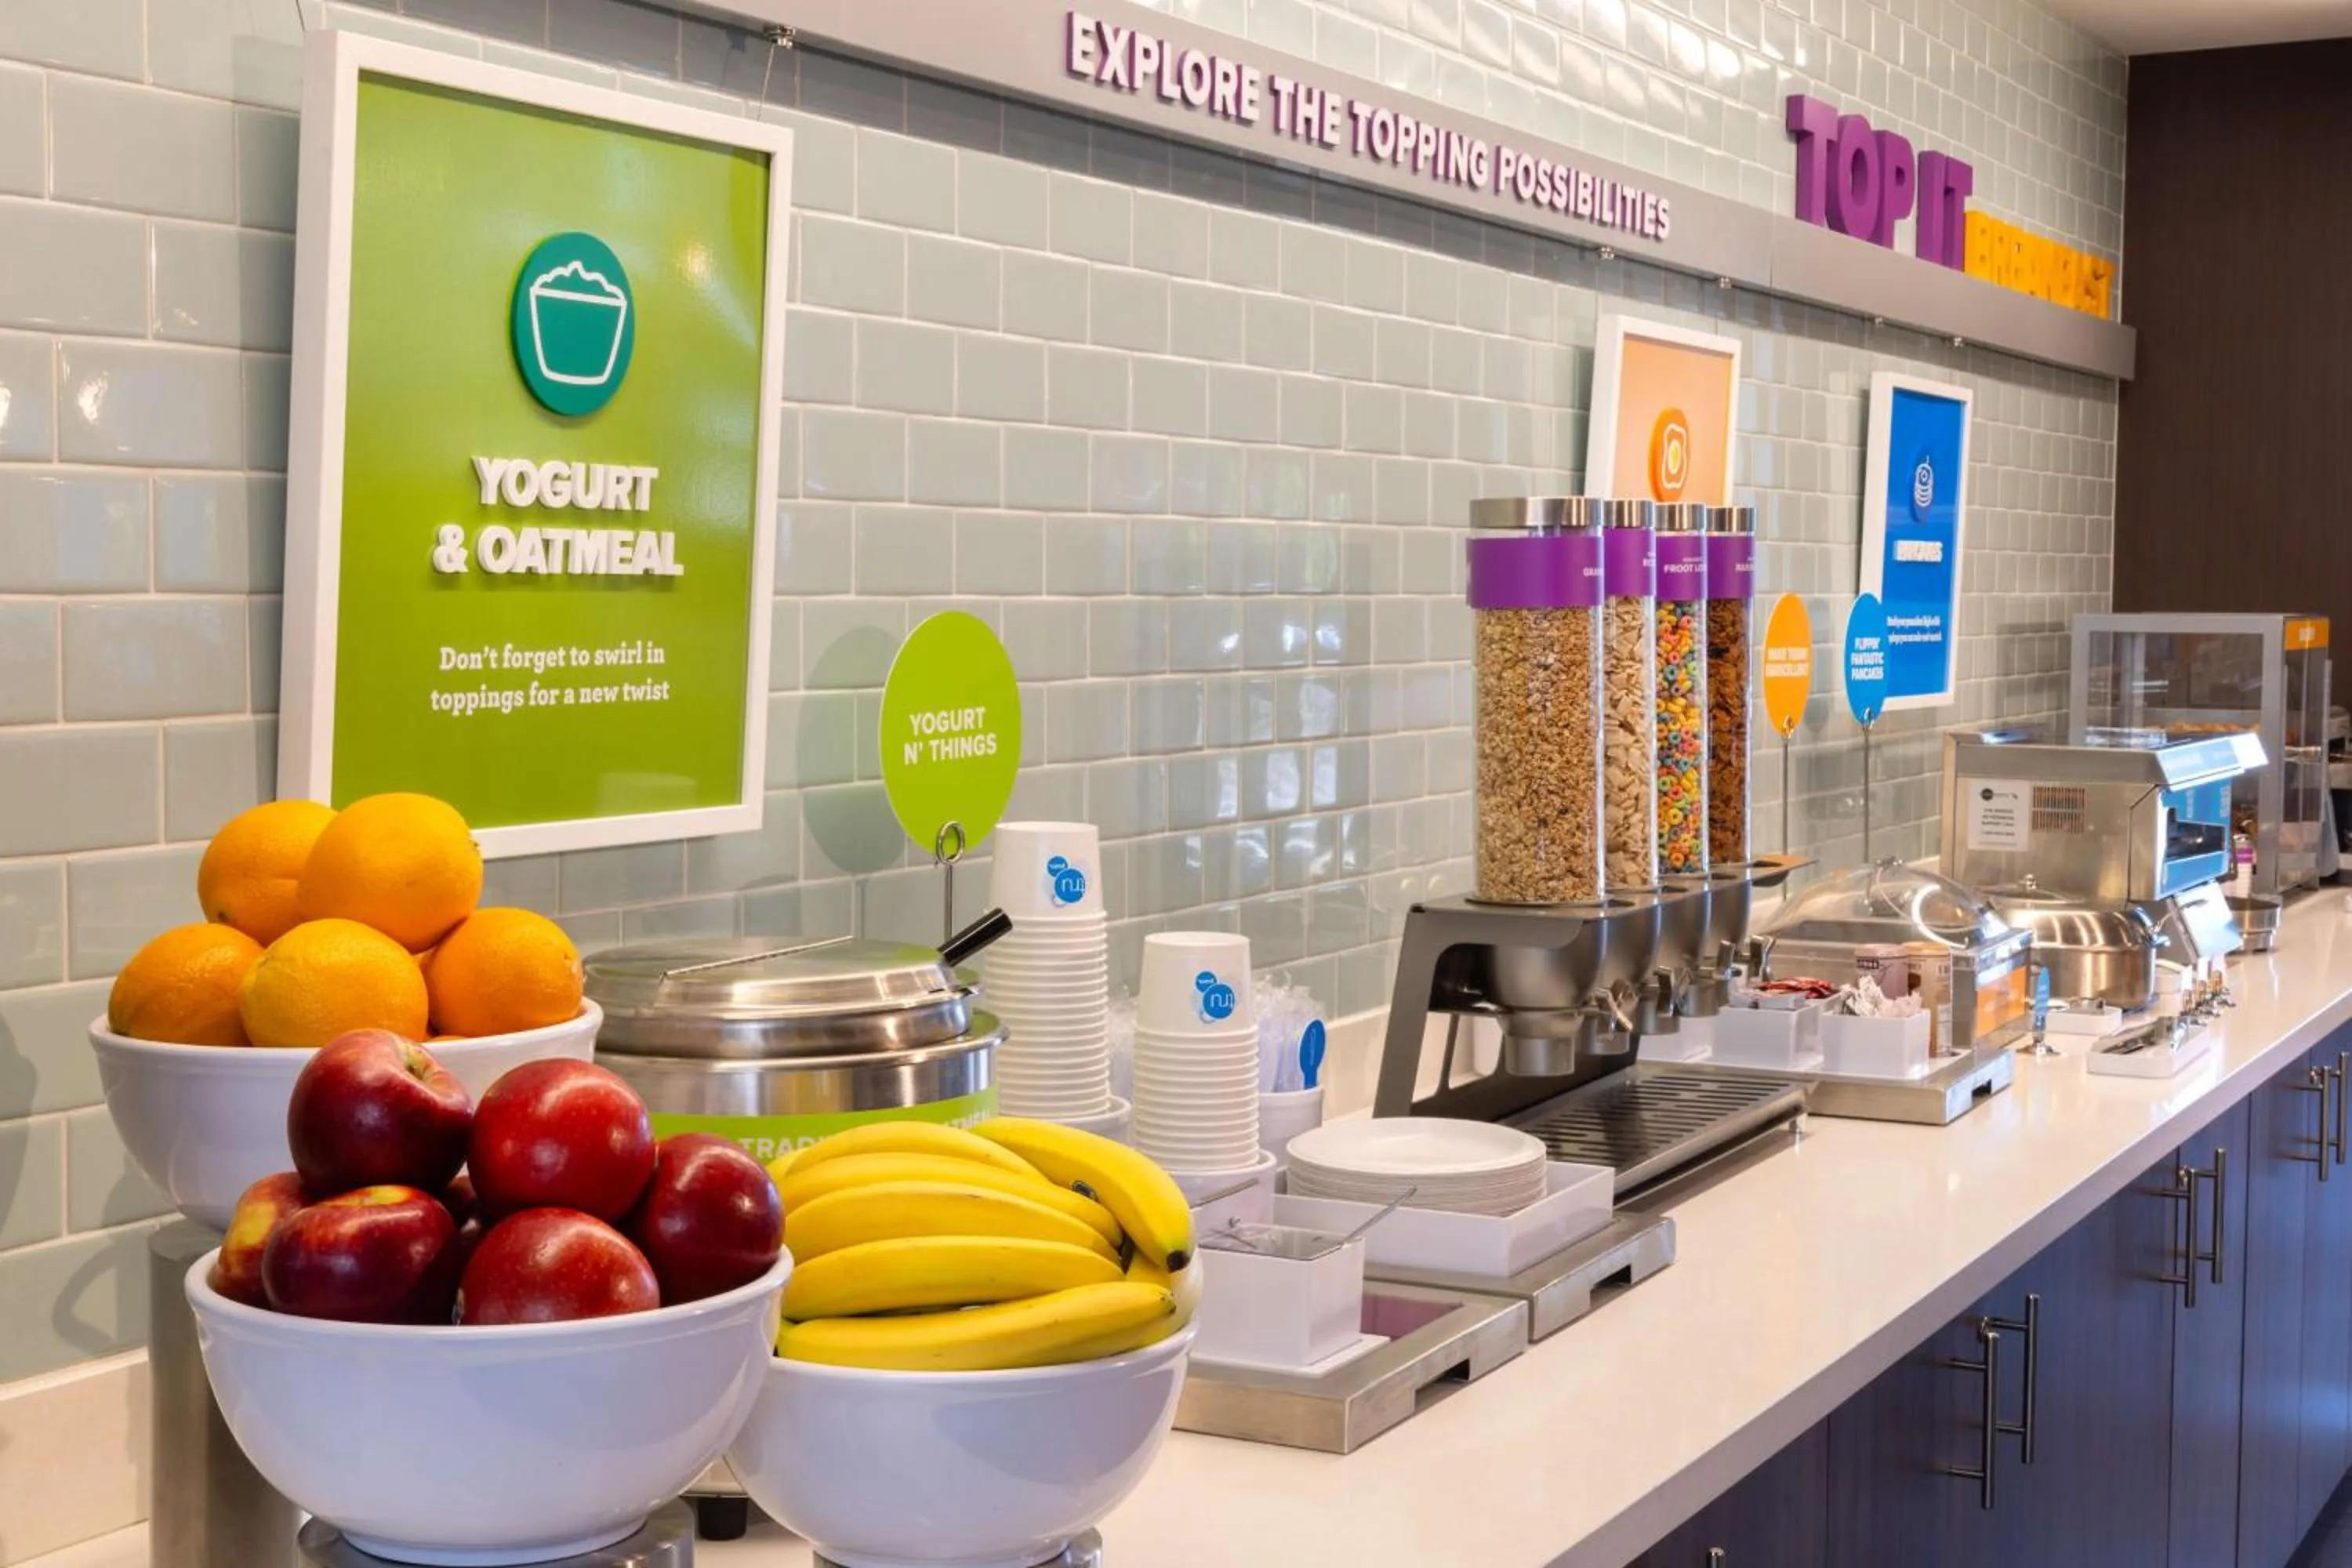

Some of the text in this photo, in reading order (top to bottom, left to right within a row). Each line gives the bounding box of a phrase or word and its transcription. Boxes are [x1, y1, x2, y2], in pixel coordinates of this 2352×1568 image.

[1066, 11, 1671, 242] EXPLORE THE TOPPING POSSIBILITIES
[1786, 94, 1915, 250] TOP
[1915, 150, 1973, 273] IT
[473, 456, 659, 511] YOGURT
[433, 524, 684, 576] & OATMEAL
[1664, 564, 1693, 575] FROOT
[503, 643, 566, 674] forget
[569, 647, 590, 667] to
[594, 641, 642, 666] swirl
[647, 641, 665, 665] in
[430, 678, 670, 715] toppings for a new twist
[909, 706, 986, 735] YOGURT
[929, 732, 997, 759] THINGS
